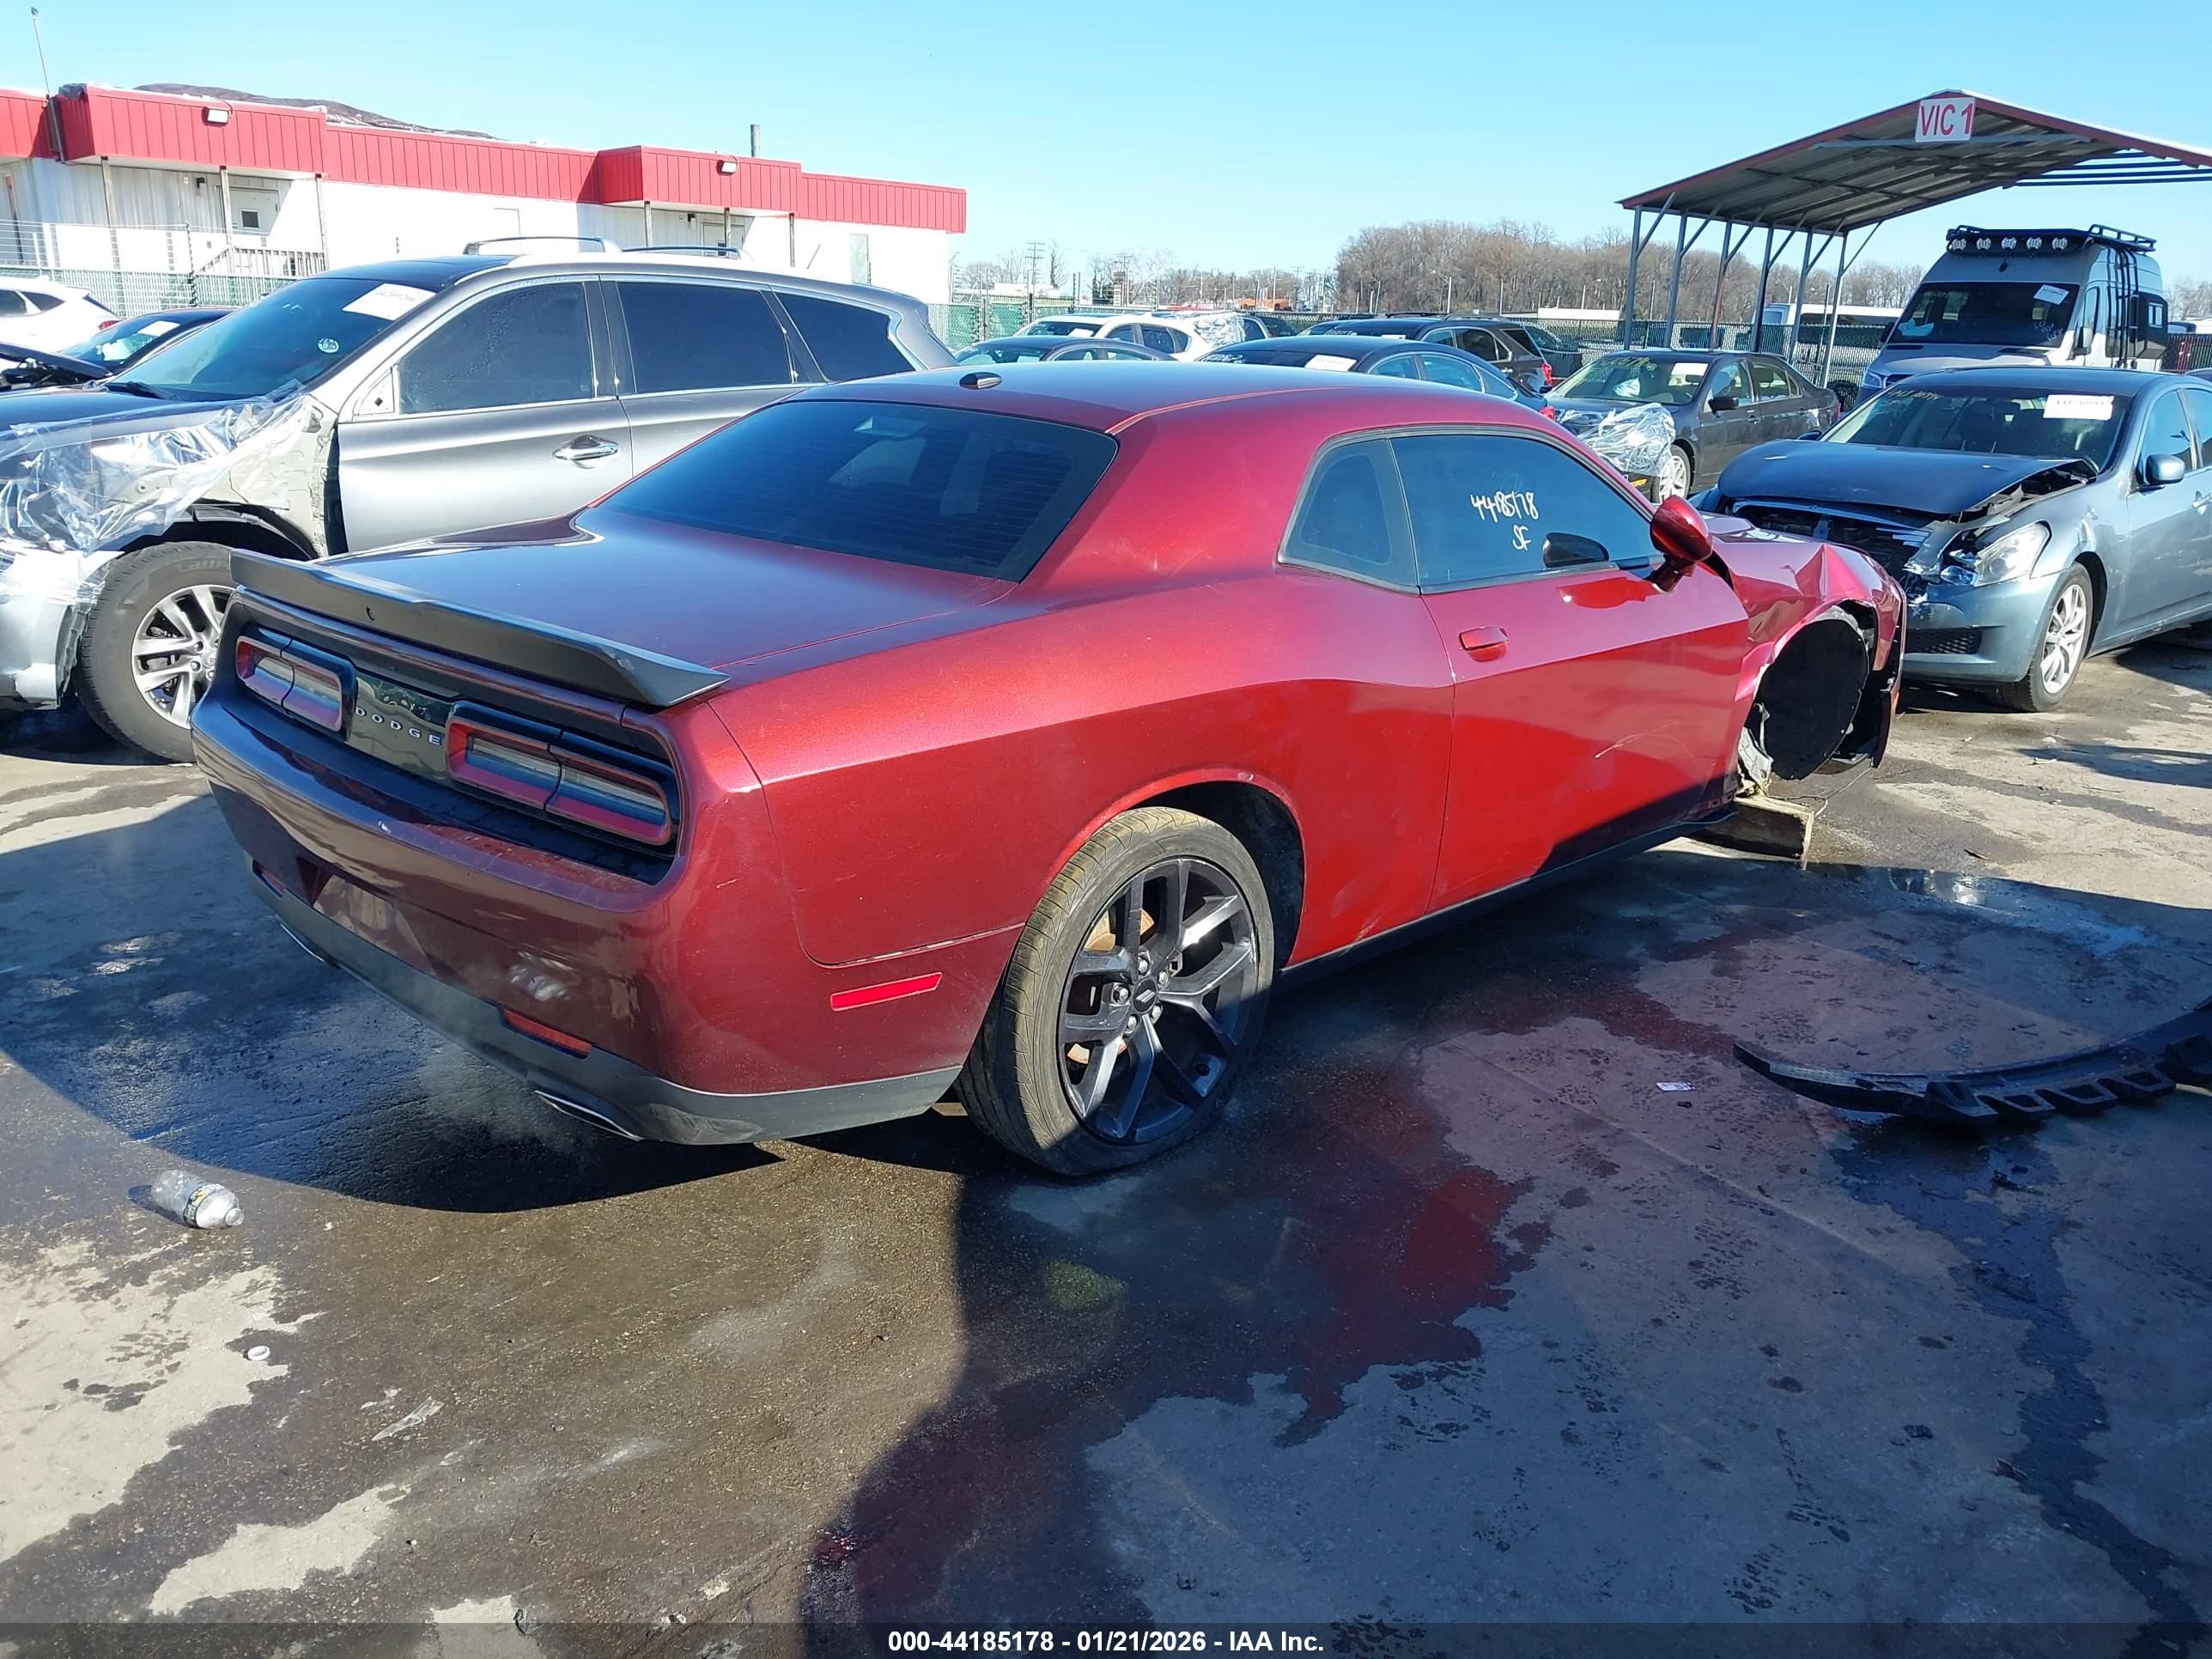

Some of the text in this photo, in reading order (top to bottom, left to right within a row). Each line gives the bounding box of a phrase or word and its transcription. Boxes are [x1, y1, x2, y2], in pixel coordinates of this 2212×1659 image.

[1920, 103, 1973, 137] VIC 1
[356, 707, 441, 745] DODGE
